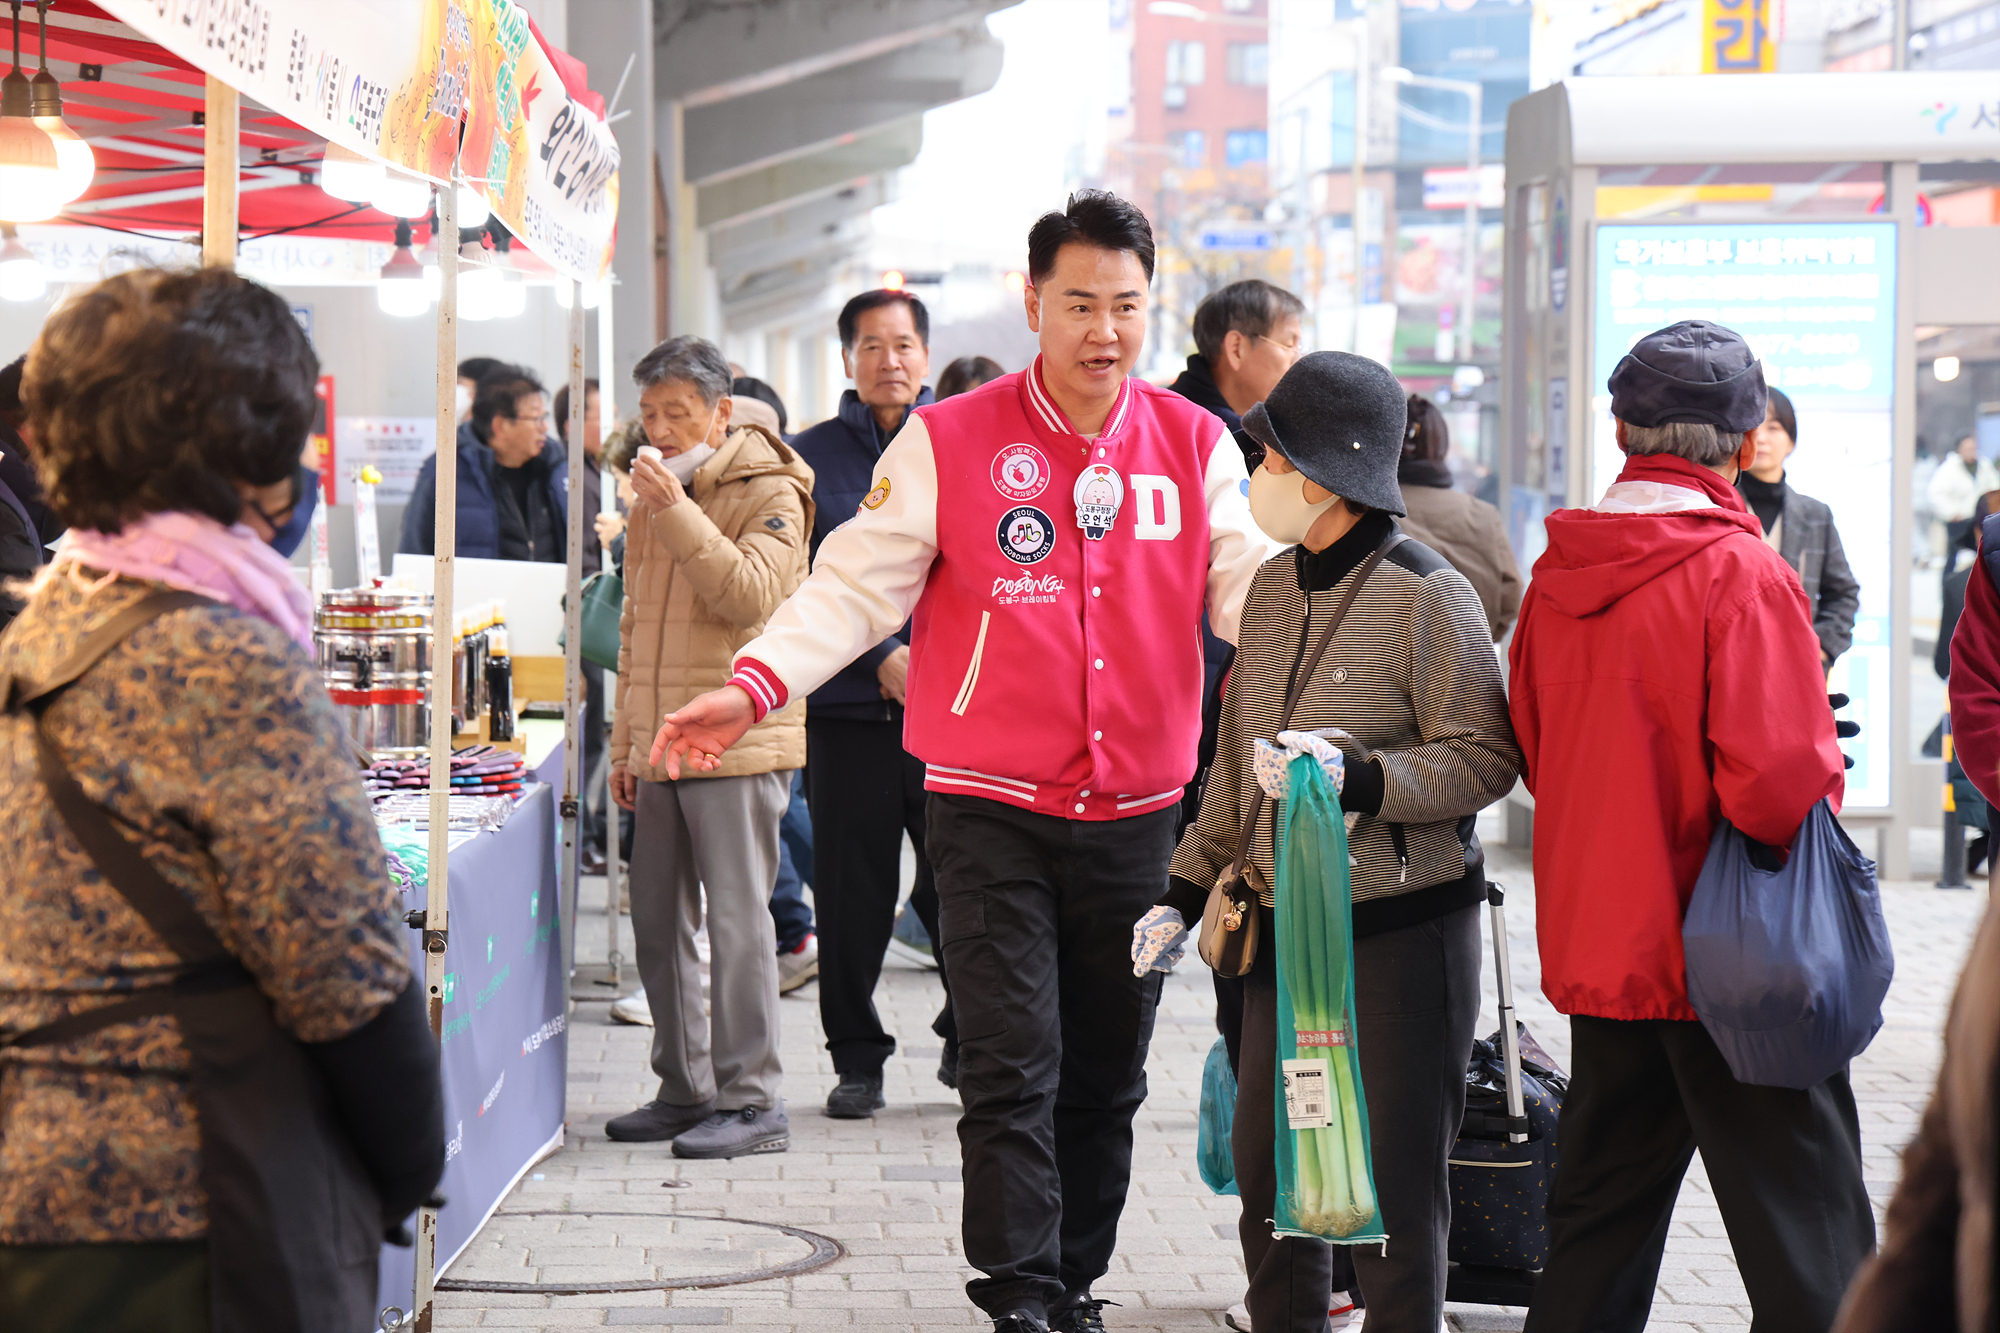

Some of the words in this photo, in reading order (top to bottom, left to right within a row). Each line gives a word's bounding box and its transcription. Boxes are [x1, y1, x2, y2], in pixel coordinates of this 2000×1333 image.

[286, 28, 309, 102] 후원
[319, 54, 349, 125] 서울시
[355, 80, 390, 146] 도봉구청
[1013, 487, 1038, 498] 약자와의
[1085, 505, 1112, 515] 도봉구청장
[1130, 474, 1182, 541] D
[1012, 509, 1035, 519] SEOUL
[1003, 544, 1032, 561] DOBONG
[1032, 541, 1051, 560] SOCKS
[998, 595, 1020, 605] 도봉구
[1021, 594, 1057, 604] 브레이킹팀
